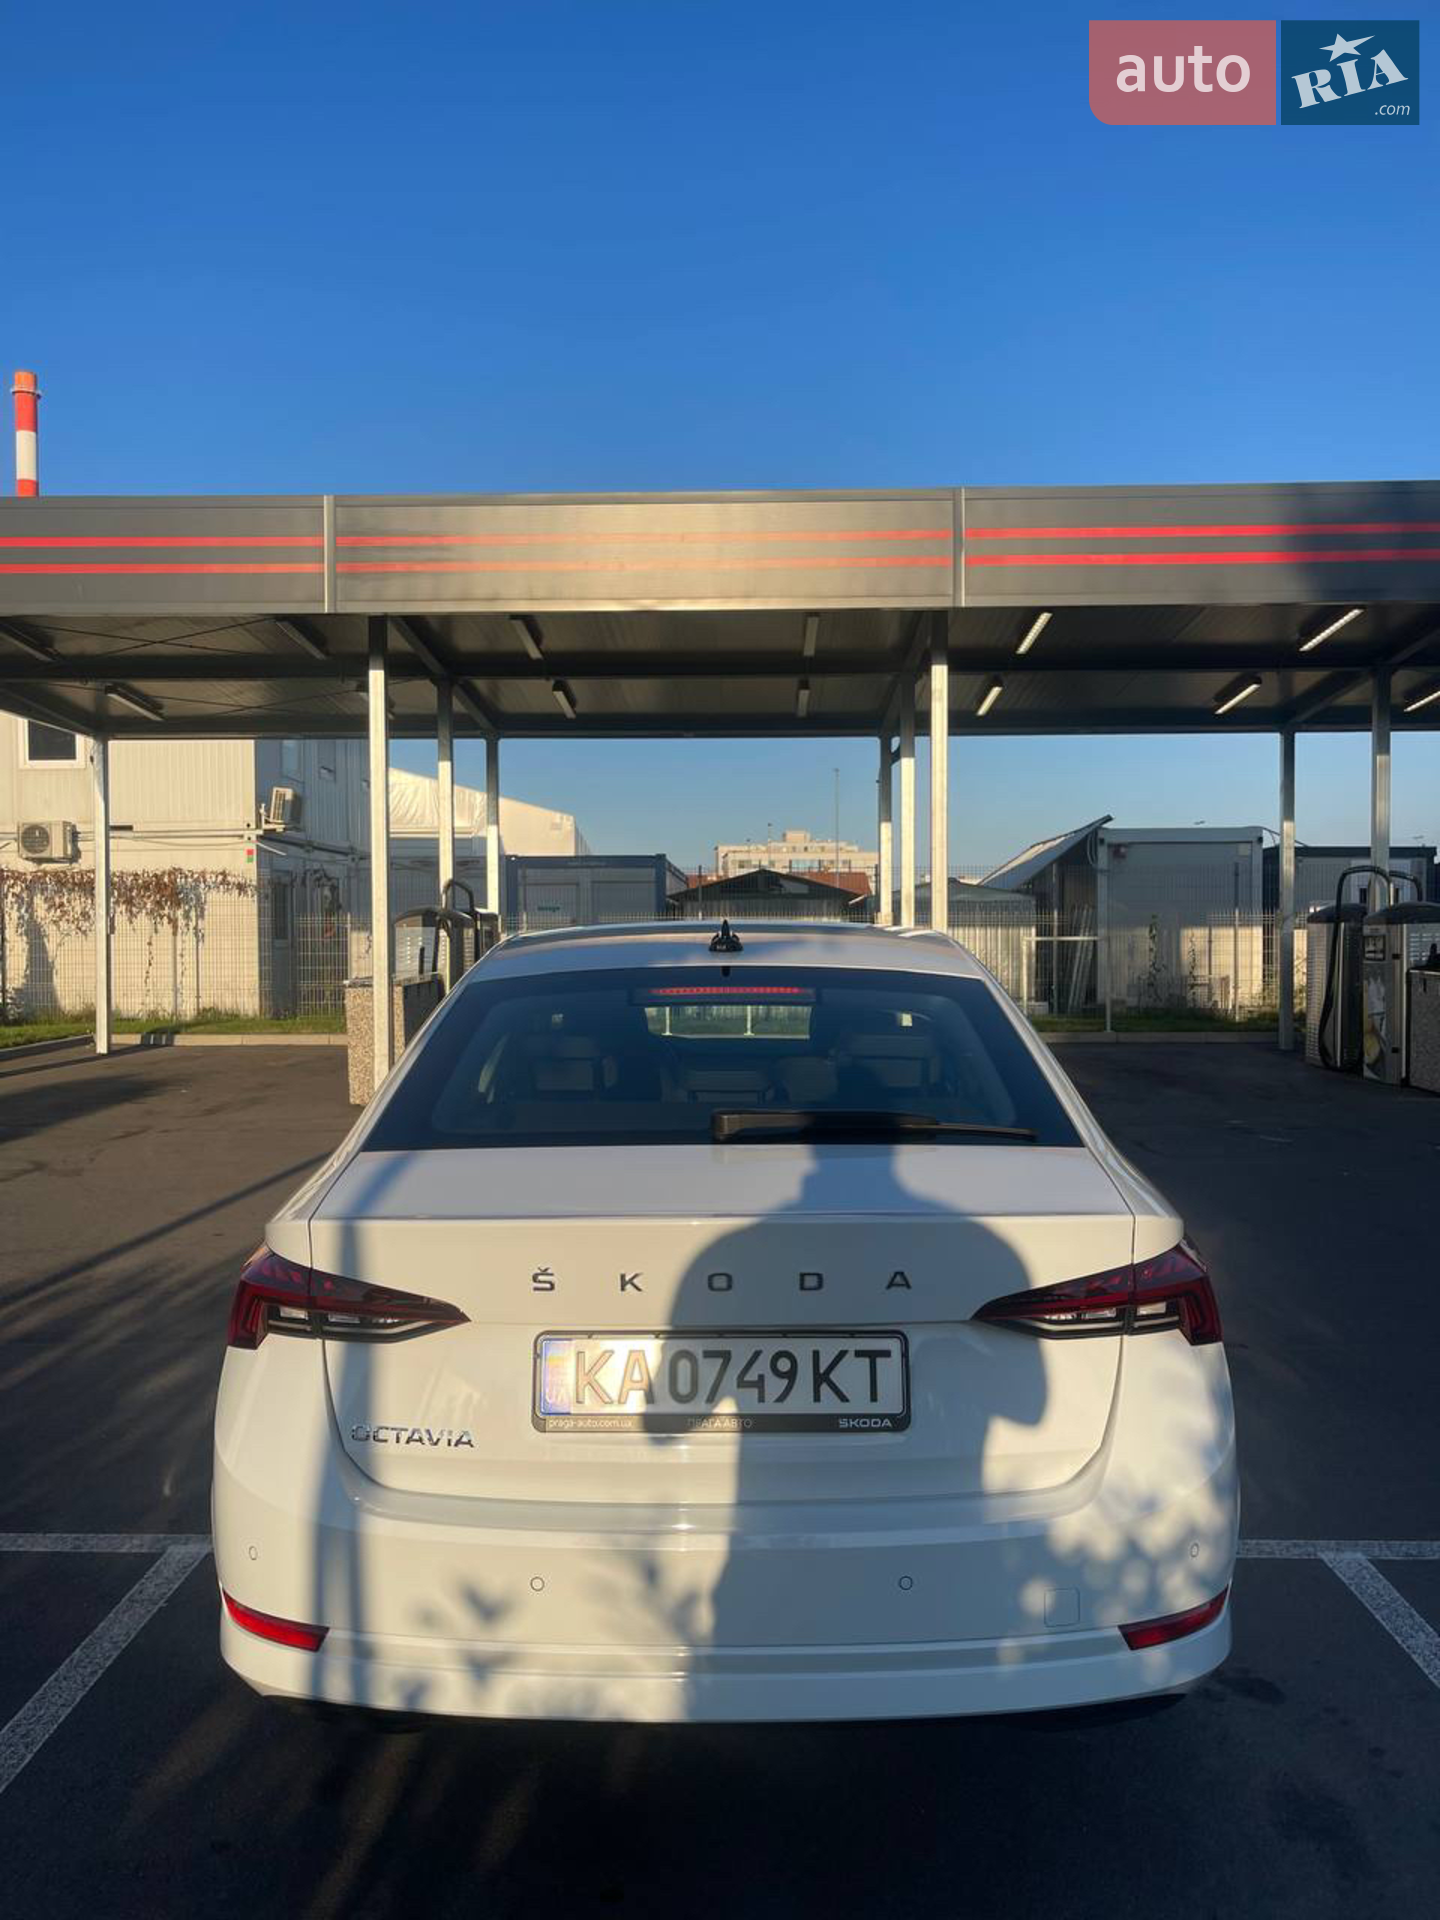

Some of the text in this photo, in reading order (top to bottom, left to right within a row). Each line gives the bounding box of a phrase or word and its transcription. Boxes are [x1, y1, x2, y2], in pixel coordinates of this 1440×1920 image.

[531, 1266, 912, 1292] ŠKODA
[548, 1418, 634, 1429] praga-auto.com.ua
[350, 1424, 475, 1449] OCTAVIA
